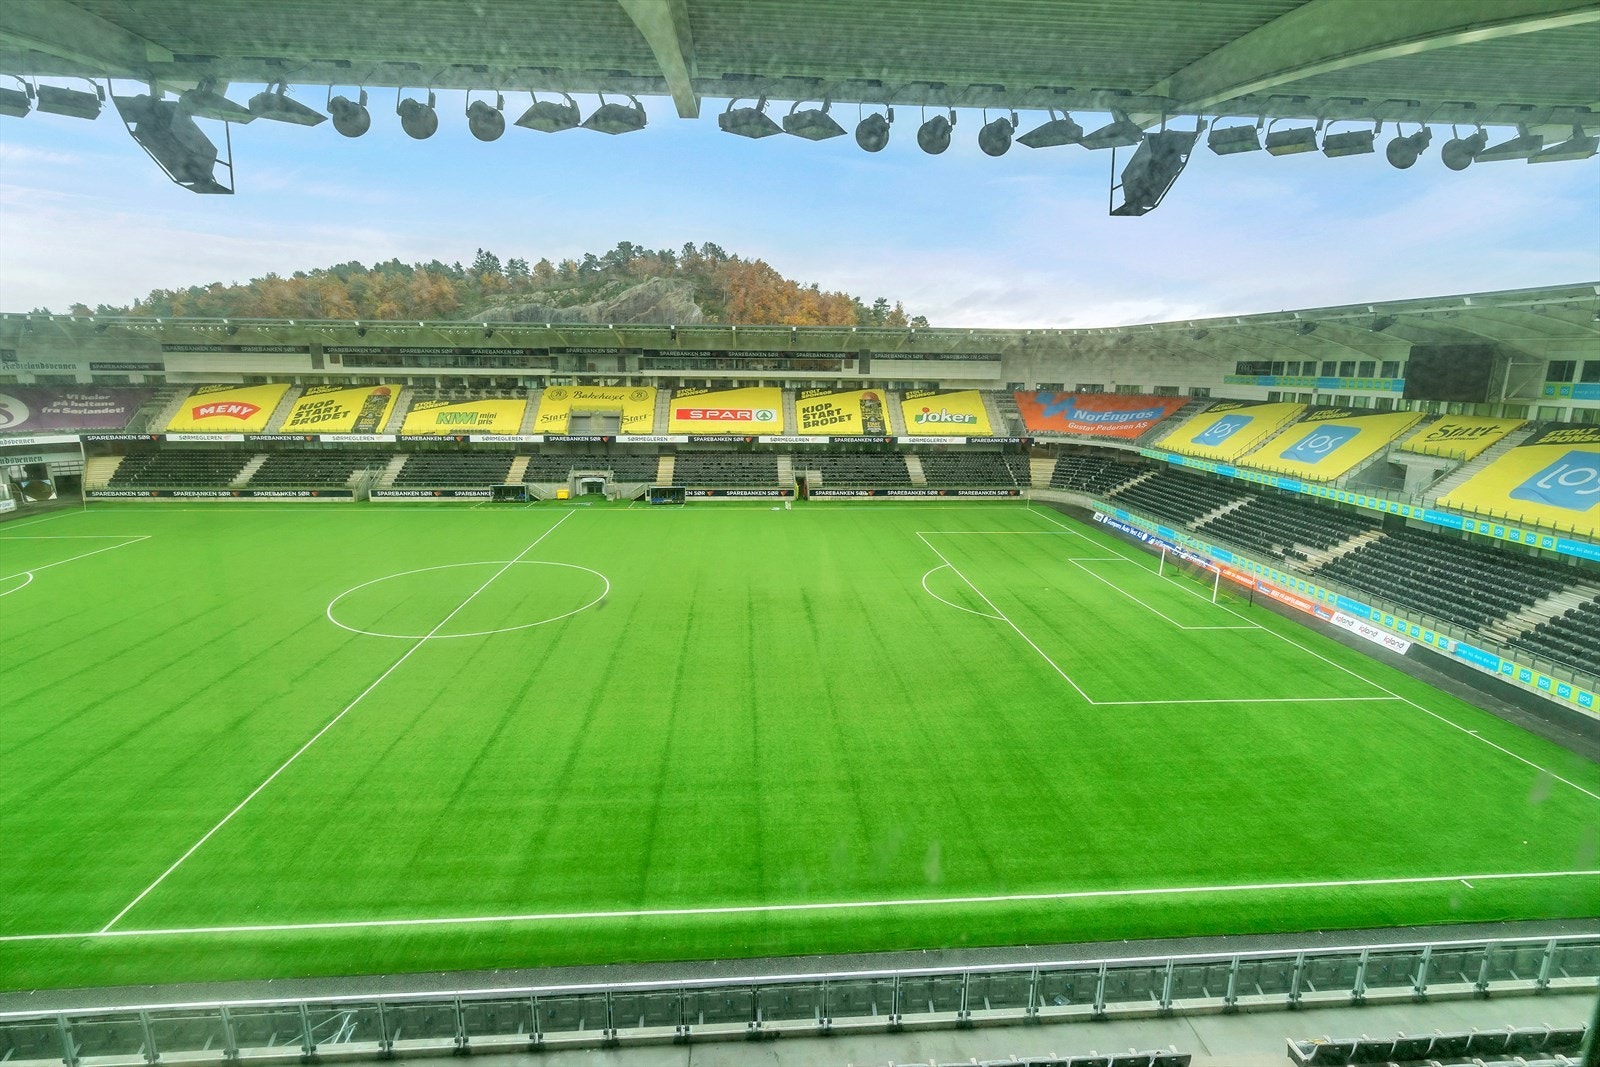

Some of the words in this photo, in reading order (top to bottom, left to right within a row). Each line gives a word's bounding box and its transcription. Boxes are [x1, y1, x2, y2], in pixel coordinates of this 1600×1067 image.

[200, 405, 254, 416] MENY
[294, 405, 343, 419] START
[689, 410, 751, 419] SPAR
[803, 408, 842, 421] START
[917, 407, 974, 425] joker
[436, 412, 479, 425] KIWI
[477, 418, 493, 426] pris
[540, 412, 568, 424] Start
[622, 414, 651, 425] Start
[1074, 410, 1153, 424] NorEngros
[1067, 421, 1095, 432] Gustav
[1096, 423, 1134, 432] Pedersen
[1135, 421, 1148, 430] AS
[1428, 424, 1504, 439] Start
[1545, 427, 1599, 437] STOLT
[1121, 523, 1131, 532] Auto
